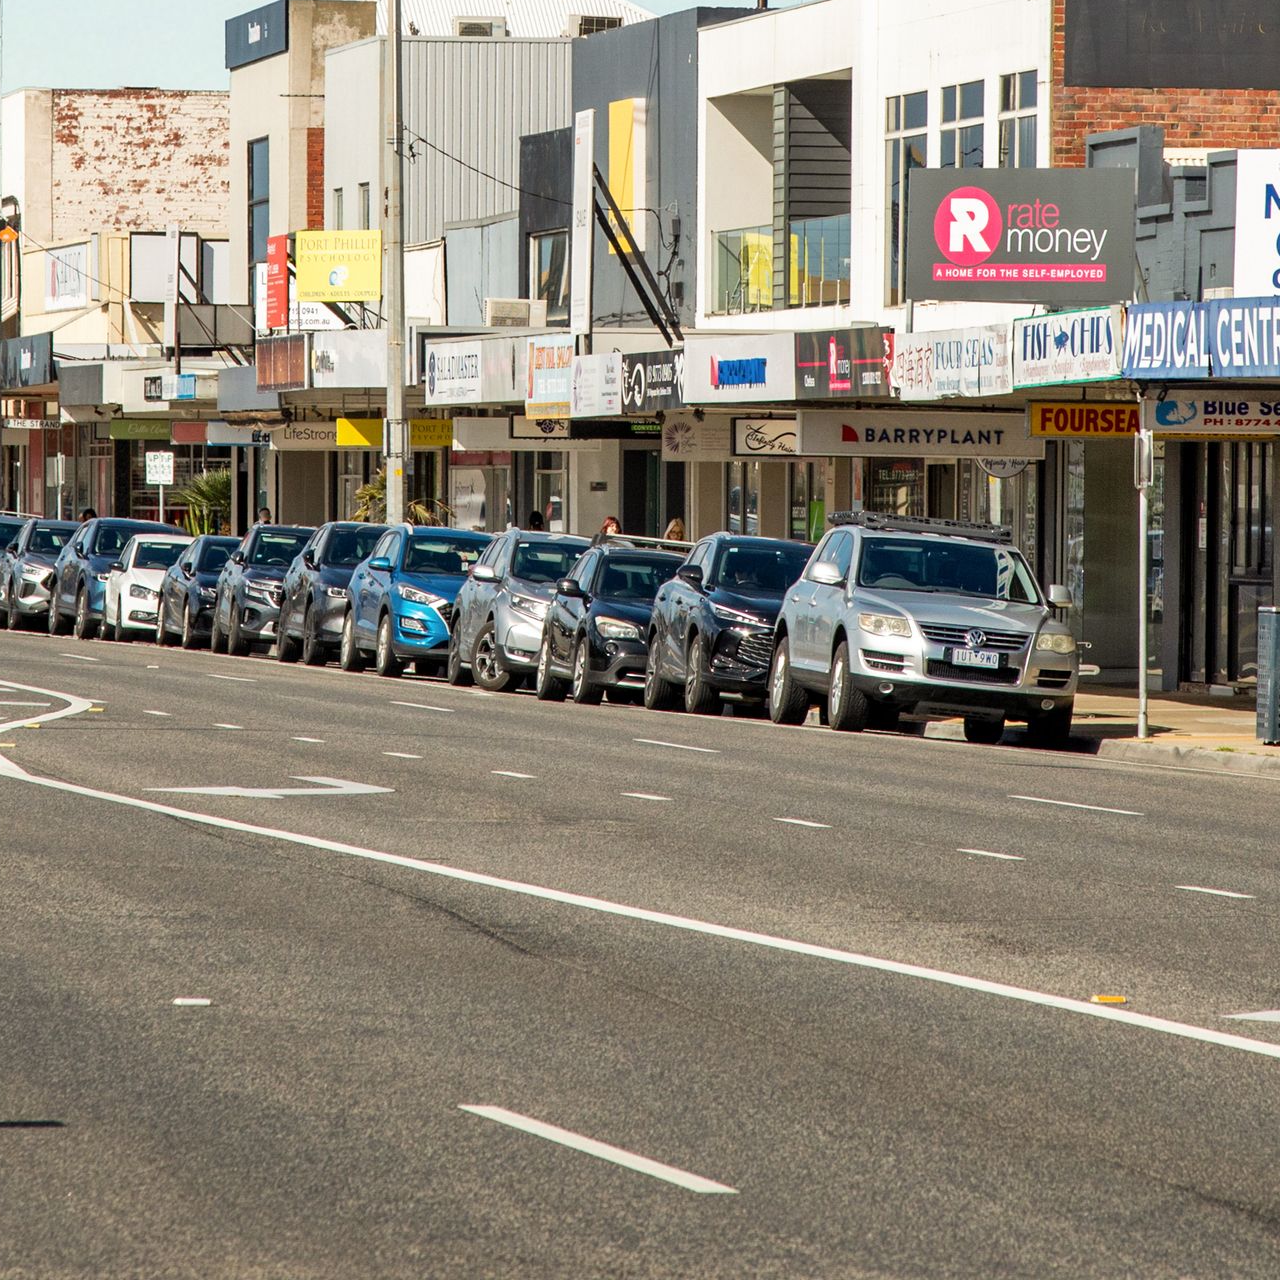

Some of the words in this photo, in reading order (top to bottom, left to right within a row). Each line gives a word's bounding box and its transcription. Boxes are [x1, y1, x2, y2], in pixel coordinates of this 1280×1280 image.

[1007, 198, 1060, 228] rate
[300, 238, 328, 251] PORT
[334, 237, 378, 250] PHILLIP
[1007, 228, 1108, 261] money
[300, 254, 377, 262] PSYCHOLOGY
[936, 269, 943, 278] A
[945, 269, 973, 278] HOME
[977, 269, 996, 278] FOR
[999, 269, 1019, 278] THE
[1022, 269, 1104, 279] SELF-EMPLOYED
[1070, 315, 1113, 358] CHIPS
[1123, 311, 1212, 369] MEDICAL
[935, 340, 963, 370] FOUR
[964, 336, 994, 368] SEAS
[13, 419, 27, 428] THE
[30, 420, 61, 429] STRAND
[412, 424, 436, 433] PORT
[1234, 418, 1272, 427] 8774
